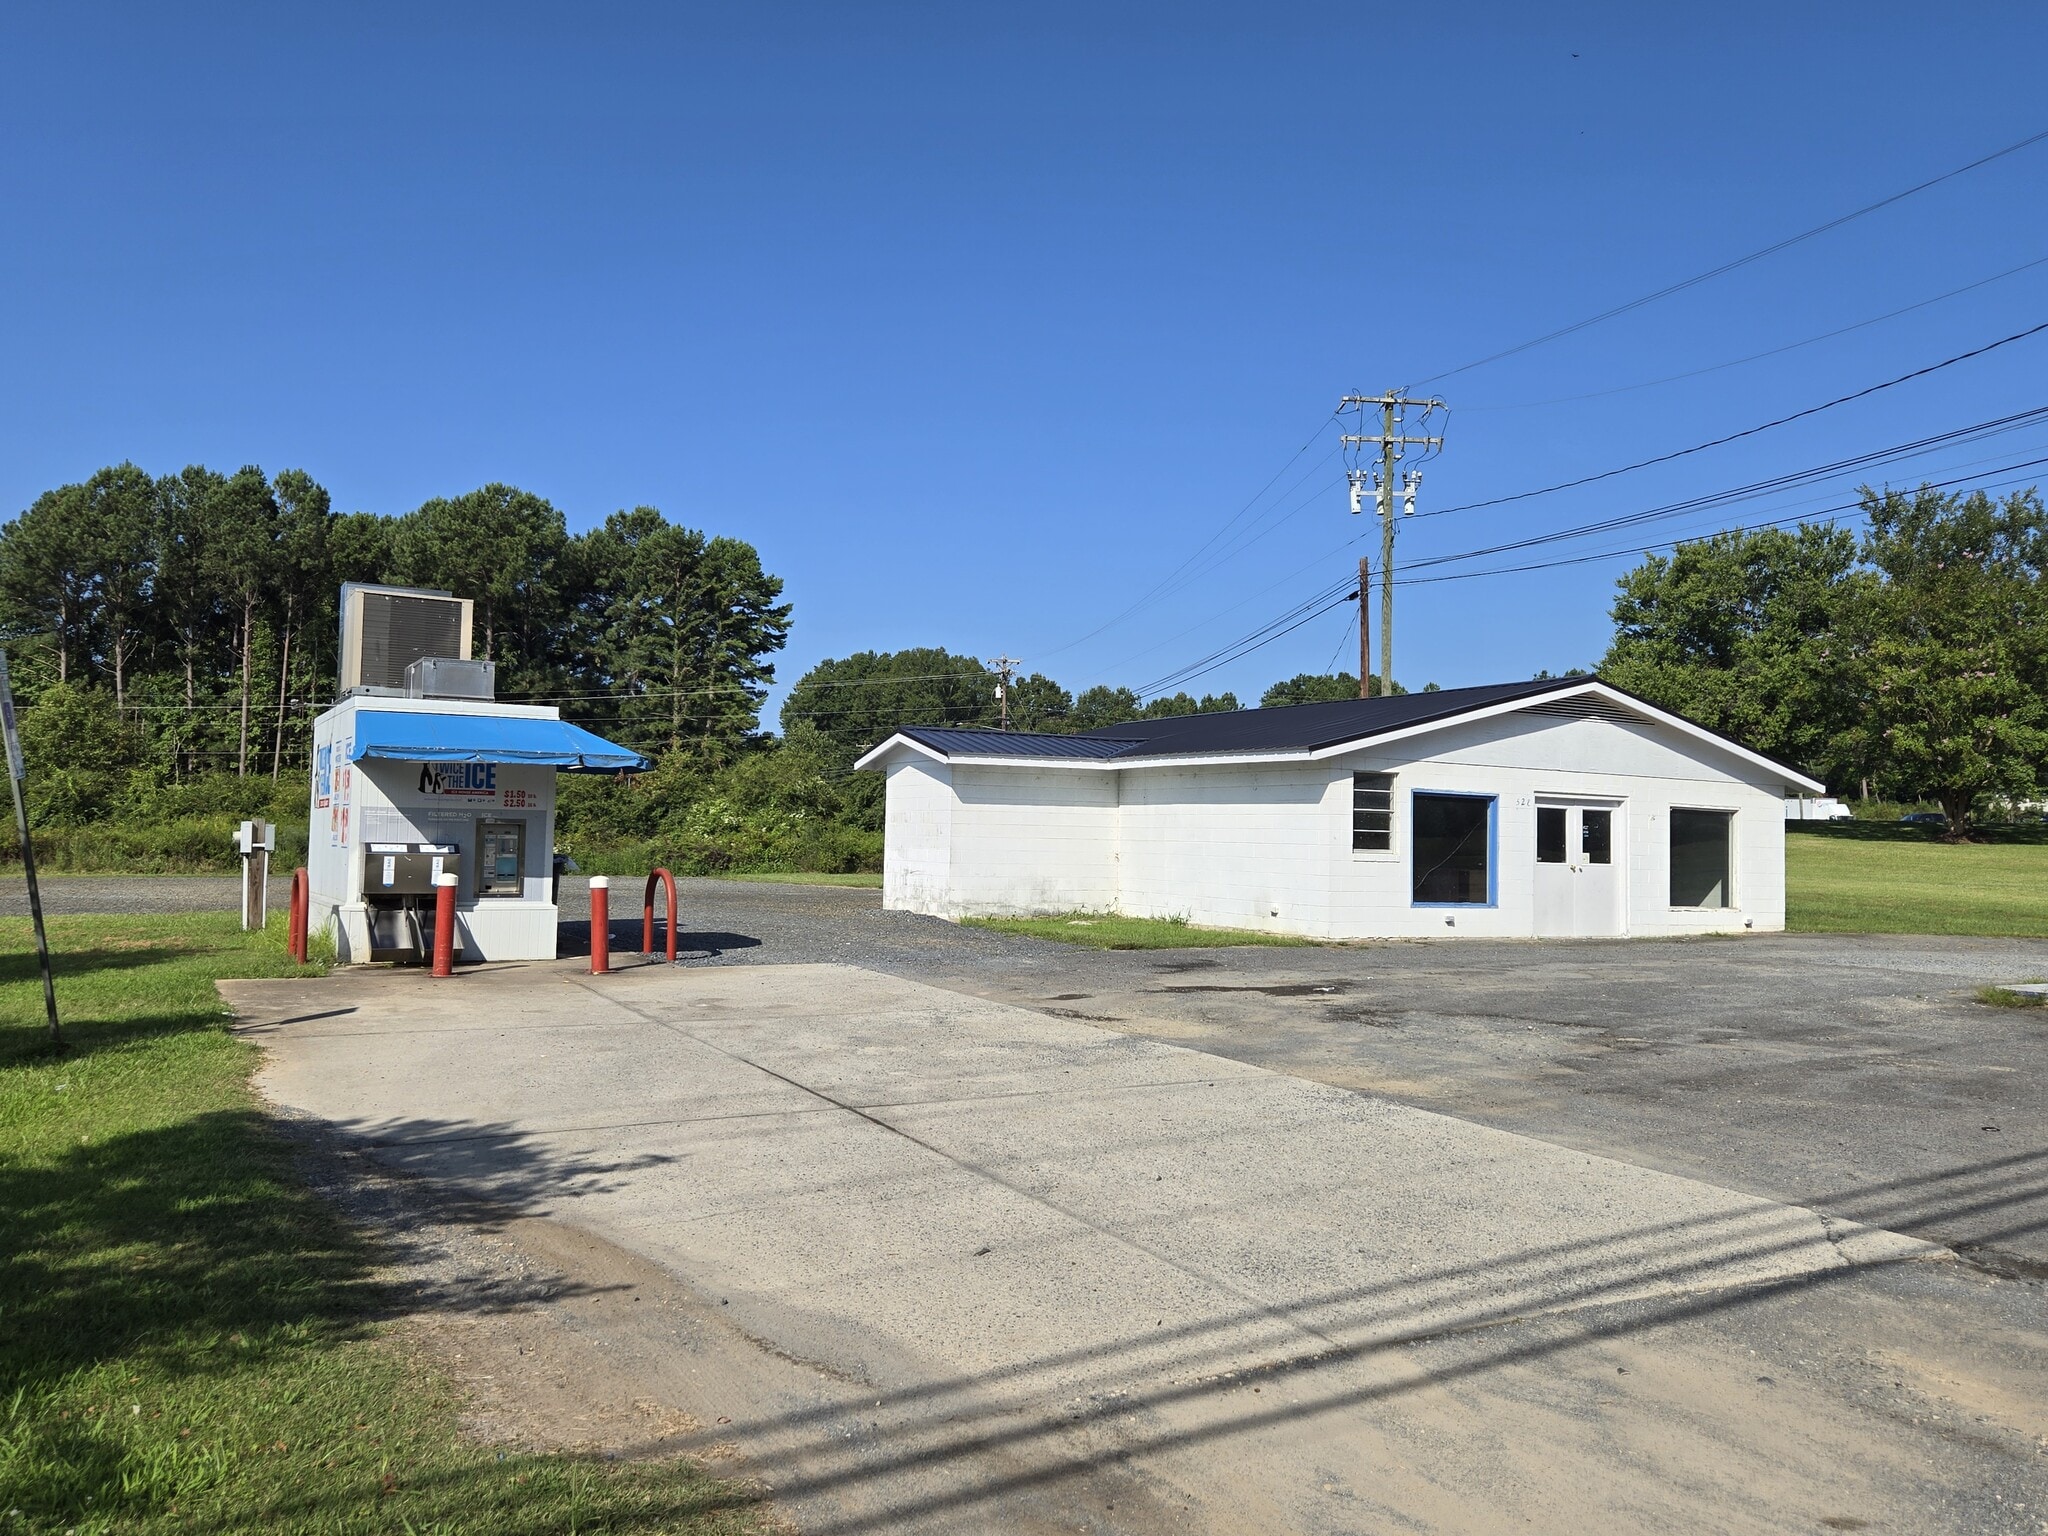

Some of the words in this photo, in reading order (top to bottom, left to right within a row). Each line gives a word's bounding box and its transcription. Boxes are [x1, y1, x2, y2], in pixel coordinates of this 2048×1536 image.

[447, 775, 464, 788] THE
[465, 763, 496, 789] ICE
[504, 790, 526, 799] $1.50
[503, 799, 526, 807] $2.50
